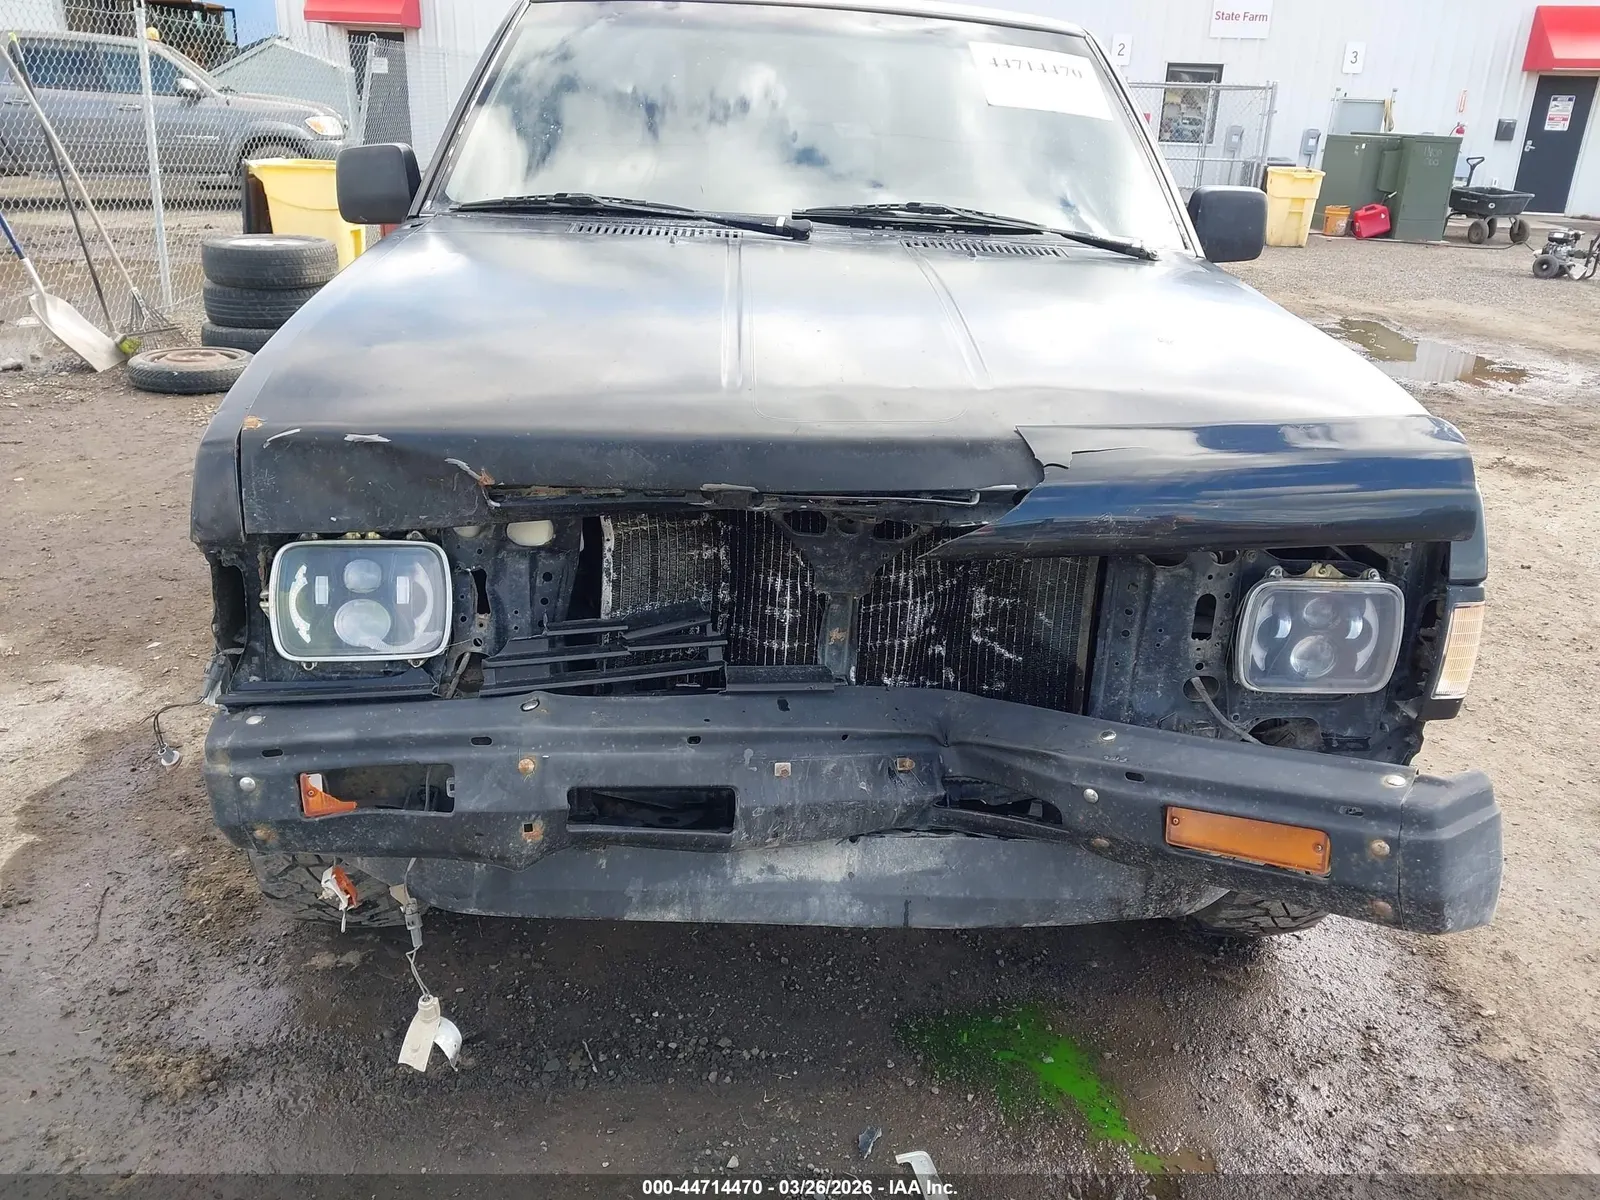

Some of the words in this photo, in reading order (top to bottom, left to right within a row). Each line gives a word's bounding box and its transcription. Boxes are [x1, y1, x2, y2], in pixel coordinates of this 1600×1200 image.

[1214, 10, 1241, 21] State
[1243, 11, 1268, 22] Farm
[1117, 42, 1126, 56] 2
[1350, 50, 1358, 64] 3
